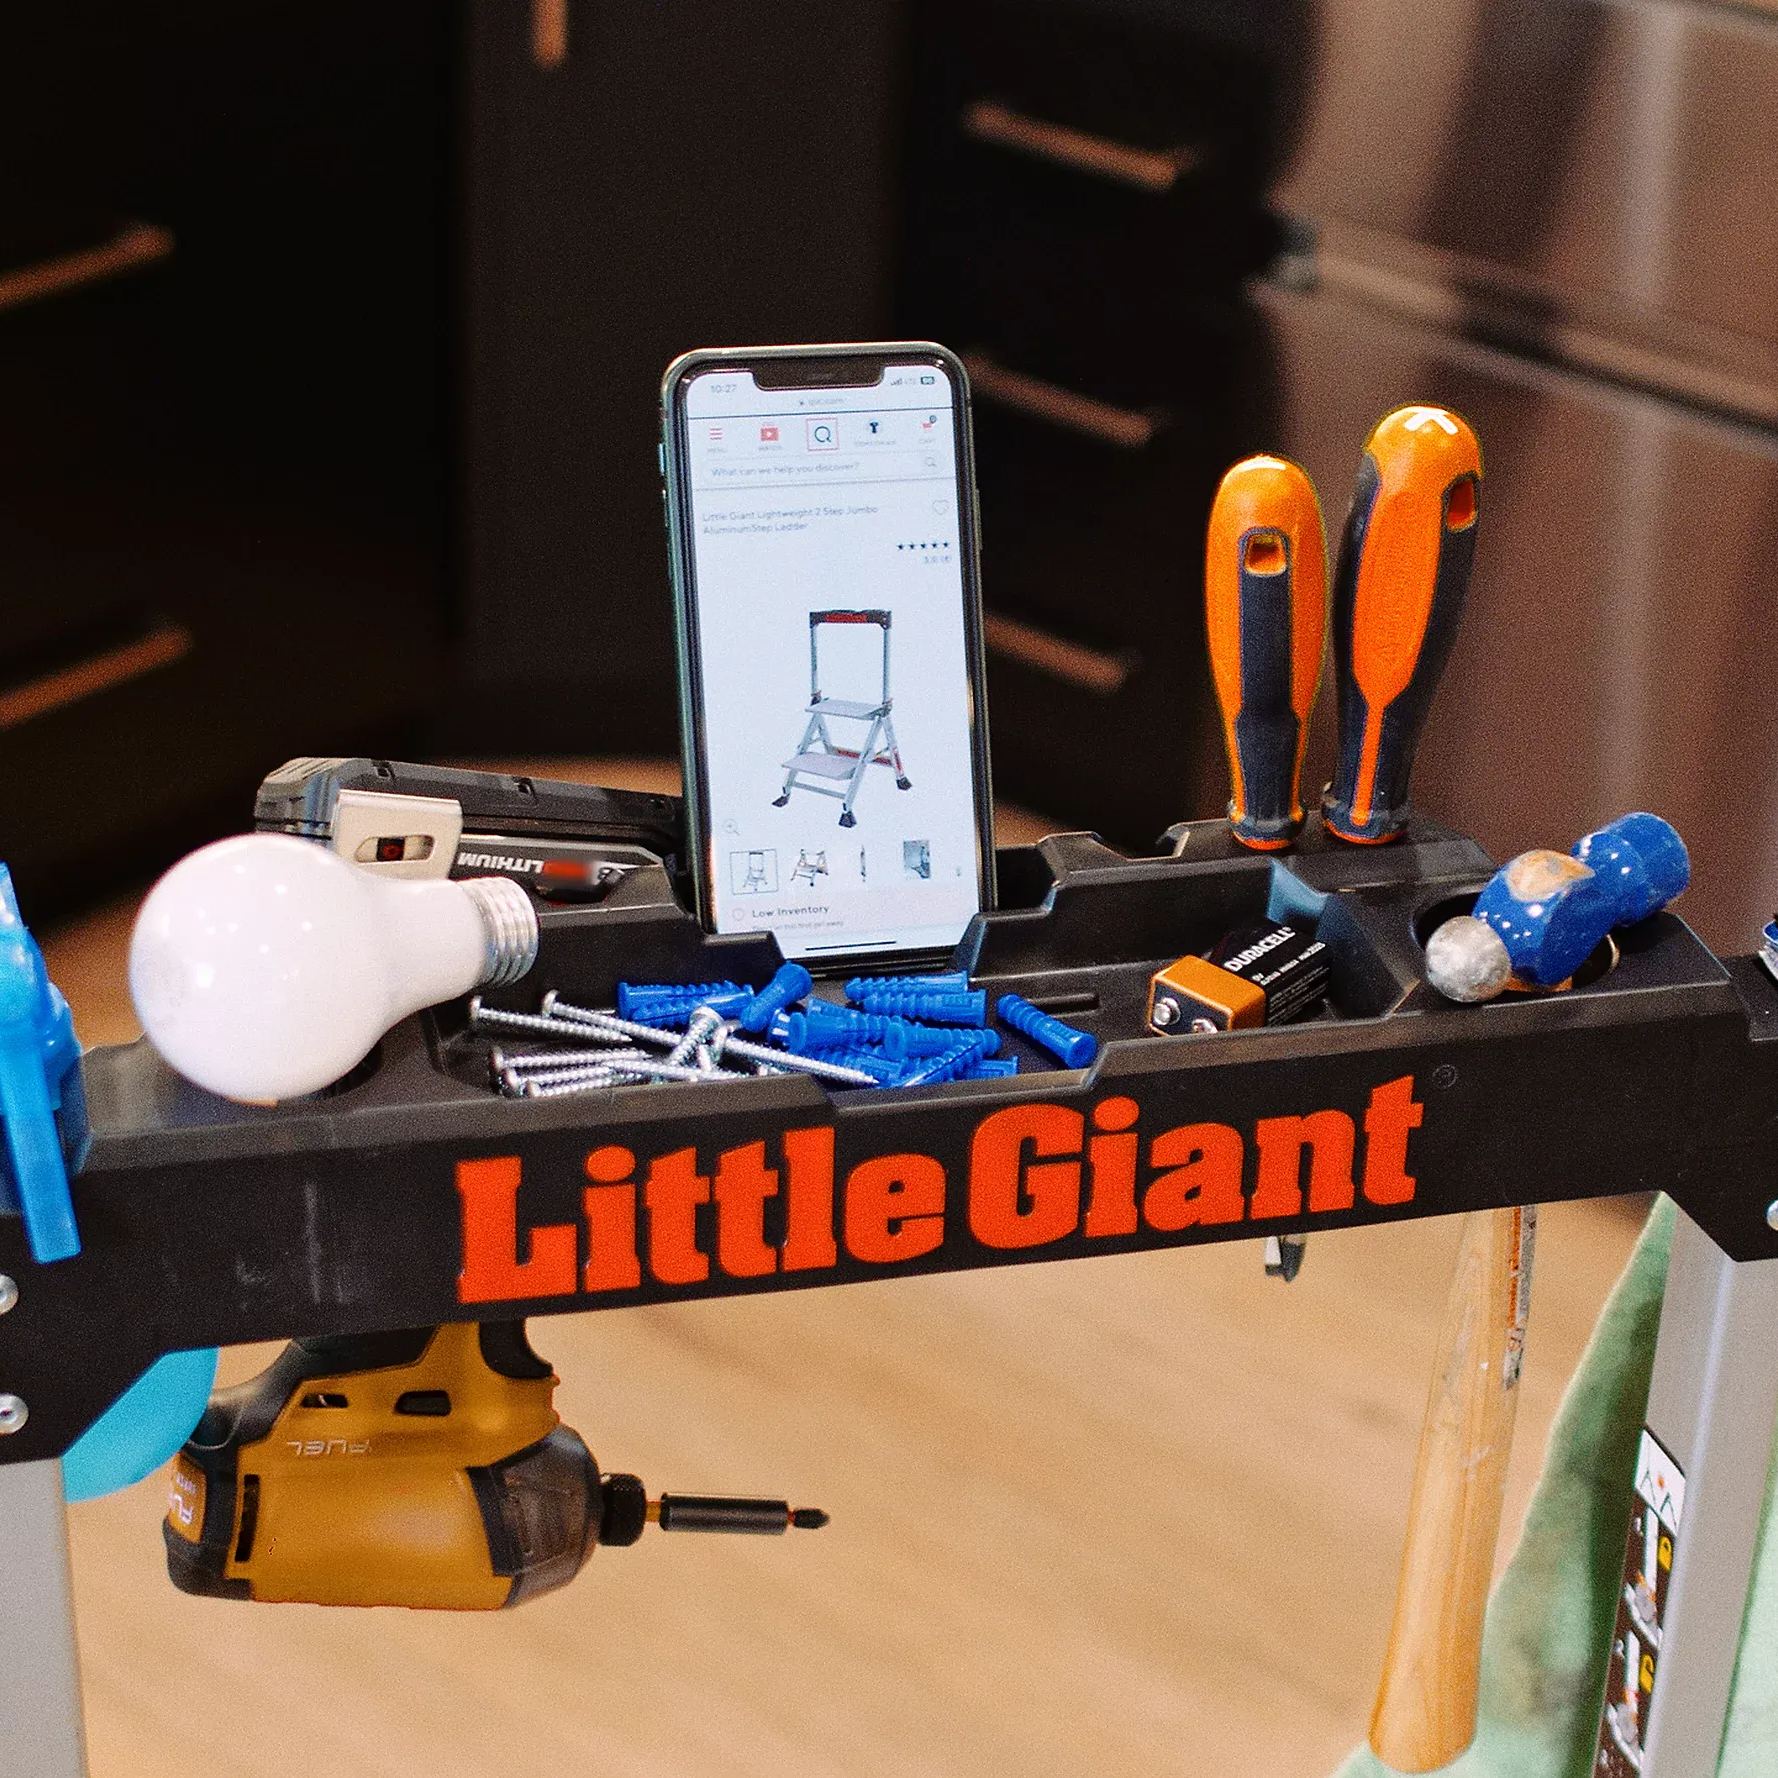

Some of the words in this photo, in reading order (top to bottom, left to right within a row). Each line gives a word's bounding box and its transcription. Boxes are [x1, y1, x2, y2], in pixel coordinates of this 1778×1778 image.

[711, 467, 737, 477] What
[739, 468, 756, 476] can
[773, 465, 795, 475] help
[796, 465, 814, 475] you
[702, 512, 727, 522] Little
[729, 511, 755, 521] Giant
[757, 508, 813, 520] Lightweight
[814, 507, 821, 516] 2
[823, 505, 844, 517] Step
[846, 505, 878, 515] Jumbo
[775, 522, 809, 532] Ladder
[457, 851, 546, 874] LITHIUM
[752, 909, 774, 918] Low
[777, 905, 829, 916] Inventory
[1222, 928, 1296, 973] DURACELL
[457, 1127, 946, 1303] Little
[969, 1075, 1423, 1248] Giant
[286, 1439, 370, 1456] FUEL
